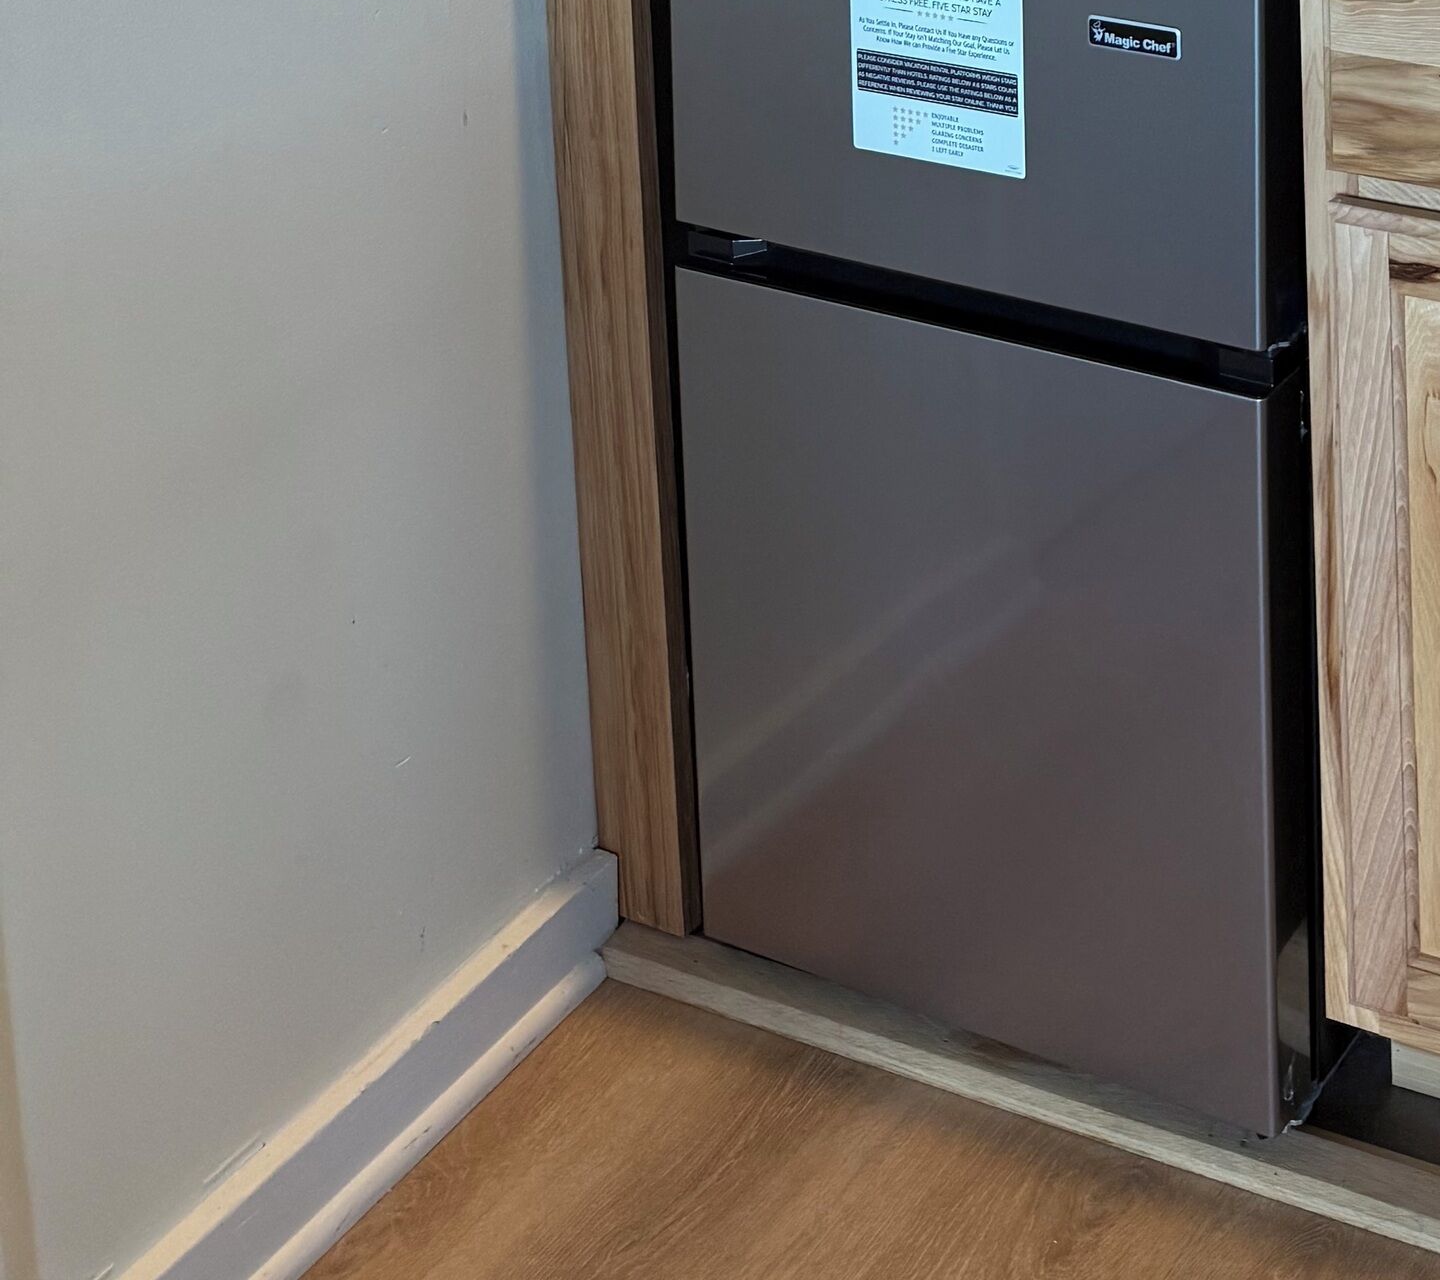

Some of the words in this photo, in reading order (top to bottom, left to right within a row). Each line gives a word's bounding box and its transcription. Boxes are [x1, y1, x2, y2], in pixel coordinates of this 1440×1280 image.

[932, 1, 949, 11] FIVE
[952, 4, 970, 15] STAR
[973, 7, 993, 18] STAY
[995, 0, 1001, 7] A
[1104, 32, 1140, 49] Magic
[1143, 39, 1171, 53] Chef
